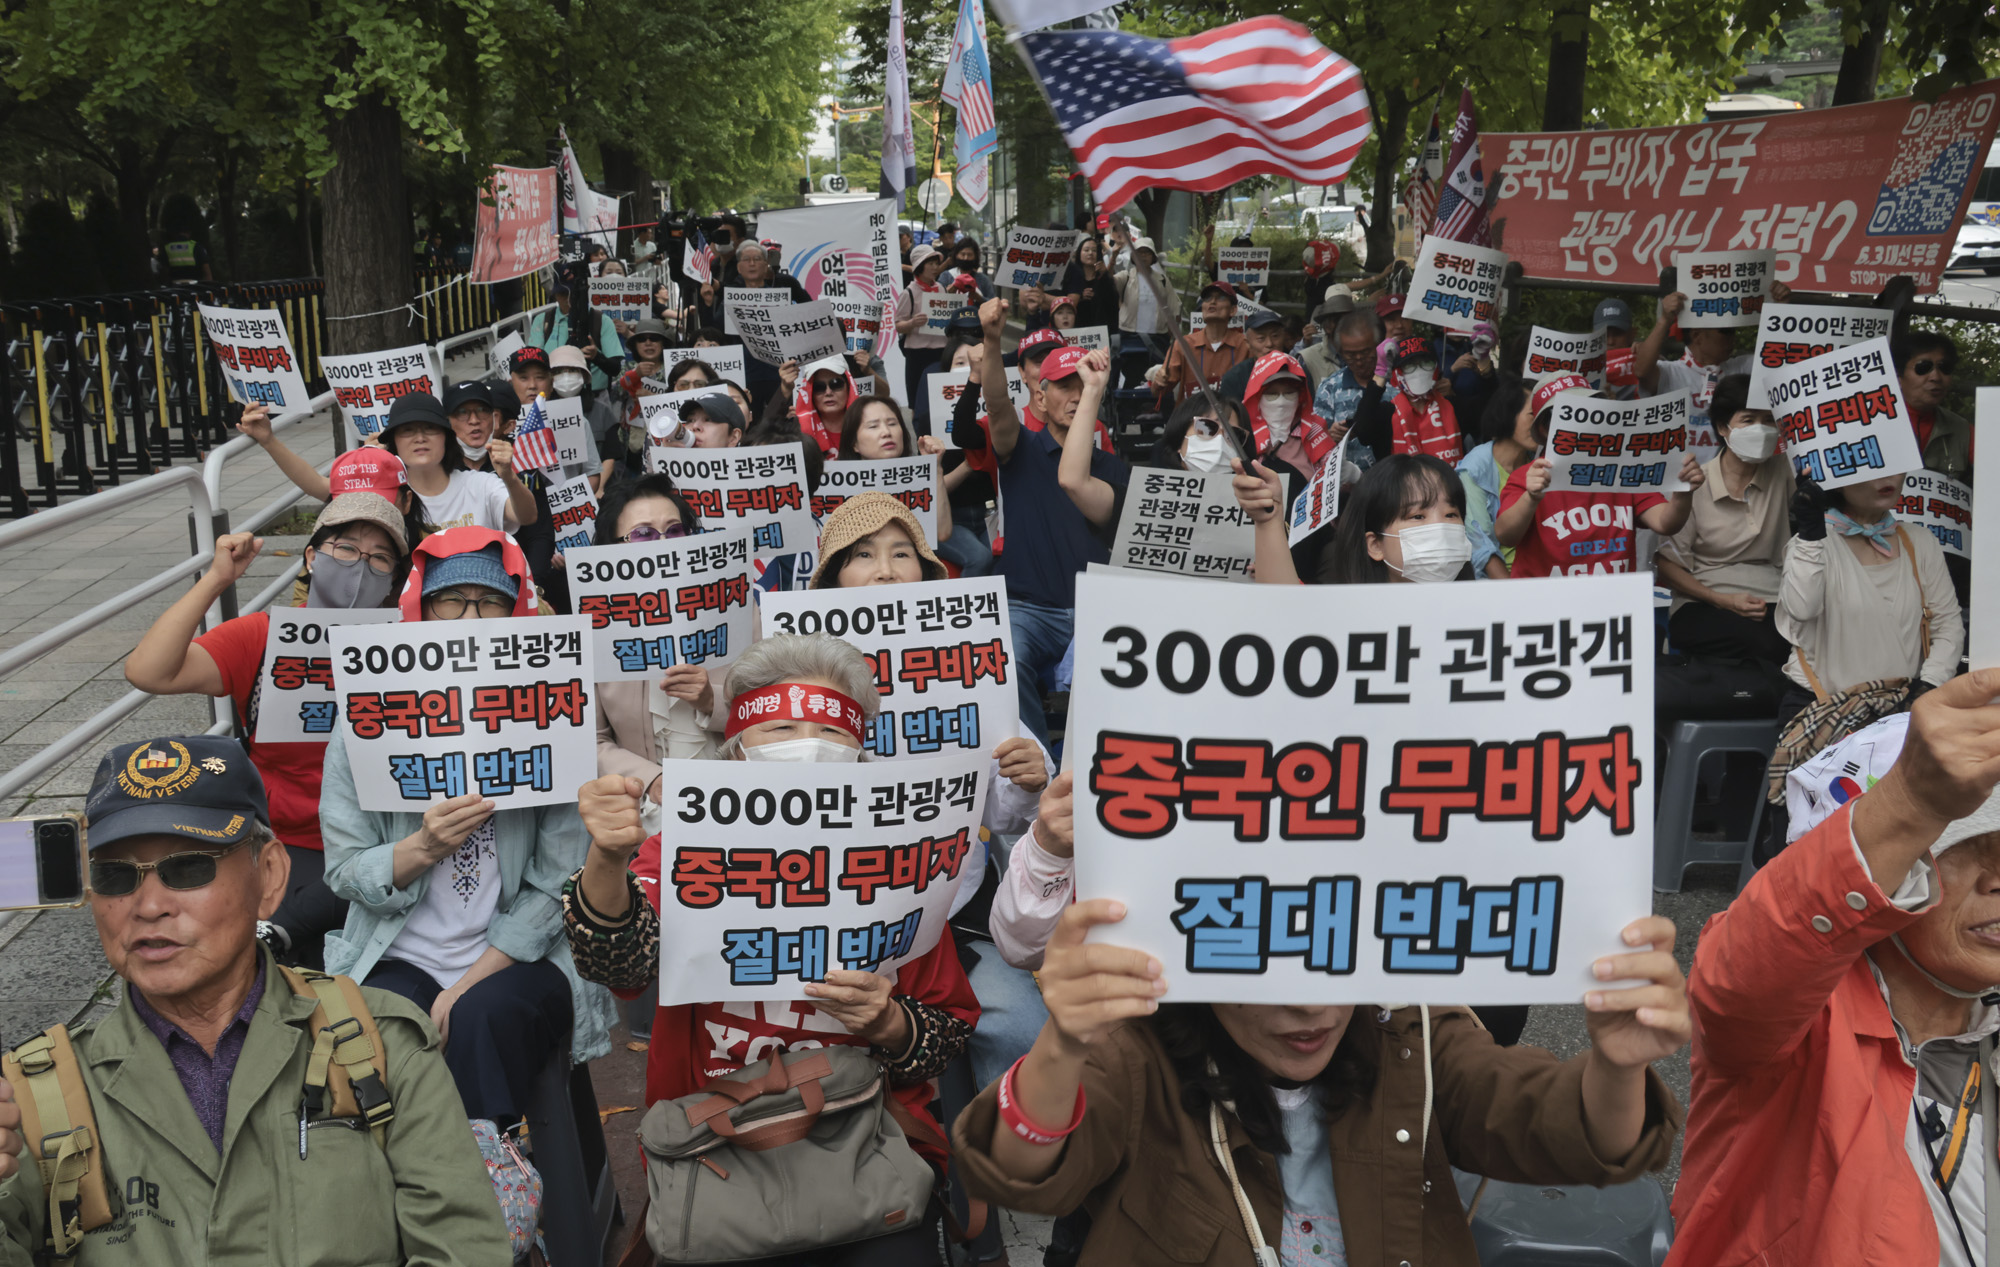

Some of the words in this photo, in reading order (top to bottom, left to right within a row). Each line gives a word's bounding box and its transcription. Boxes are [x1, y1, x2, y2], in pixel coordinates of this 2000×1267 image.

[1498, 136, 1580, 200] 중국인
[1578, 129, 1680, 200] 무비자
[1679, 121, 1768, 197] 입국
[1013, 232, 1055, 248] 3000만
[1560, 210, 1637, 277] 관광
[1007, 247, 1045, 268] 중국인
[1220, 250, 1249, 259] 3000만
[1433, 252, 1476, 277] 중국인
[1690, 263, 1732, 280] 중국인
[1735, 261, 1768, 277] 관광객
[1850, 271, 1878, 286] STOP
[591, 282, 625, 291] 3000만
[626, 282, 650, 291] 관광객
[727, 293, 762, 301] 3000만
[765, 292, 789, 301] 관광객
[1698, 278, 1761, 294] 3000만명
[733, 307, 771, 323] 중국인
[1421, 289, 1473, 319] 무비자
[1690, 297, 1740, 317] 무비자
[237, 319, 282, 338] 관광객
[739, 321, 777, 337] 관광객
[779, 314, 835, 338] 유치보다
[1080, 334, 1101, 343] 관광객
[1767, 315, 1847, 338] 3000만
[1850, 317, 1889, 339] 관광객
[670, 350, 700, 362] 중국인
[1059, 352, 1071, 363] STOP
[1072, 351, 1081, 359] THE
[1534, 335, 1588, 355] 3000만
[237, 345, 293, 373] 무비자
[324, 362, 374, 380] 3000만
[377, 353, 427, 377] 관광객
[333, 385, 374, 409] 중국인
[373, 374, 434, 407] 무비자
[1540, 377, 1575, 400] 이재명
[1767, 371, 1819, 409] 3000만
[1823, 350, 1887, 391] 관광객
[247, 380, 287, 407] 반대
[353, 414, 381, 437] 절대
[1559, 404, 1641, 428] 3000만
[1643, 398, 1687, 427] 관광객
[1777, 405, 1817, 446] 국인
[1817, 384, 1899, 435] 무비자
[1553, 429, 1625, 458] 중국인
[1626, 425, 1688, 457] 무비자
[338, 464, 358, 477] STOP
[358, 463, 379, 474] THE
[657, 460, 730, 481] 3000만
[735, 453, 798, 479] 관광객
[1824, 434, 1886, 479] 반대
[344, 478, 375, 491] STEAL
[820, 469, 877, 488] 000만
[881, 463, 932, 487] 관광객
[1144, 473, 1206, 499] 중국인
[1569, 463, 1618, 486] 절대
[1619, 461, 1667, 487] 반대
[547, 483, 589, 508] 관광객
[671, 488, 725, 518] 국인
[727, 481, 805, 518] 무비자
[1138, 498, 1201, 523] 관광객
[1541, 503, 1633, 540] YOON
[753, 522, 784, 552] 대
[1132, 521, 1194, 546] 자국민
[1570, 536, 1627, 557] GREAT
[576, 551, 681, 583] 3000만
[686, 538, 748, 574] 관광객
[1127, 545, 1188, 571] 안전이
[579, 588, 673, 630] 중국인
[675, 572, 750, 621] 무비자
[915, 591, 1001, 633] 관광객
[342, 636, 481, 676] 3000만
[489, 630, 583, 672] 관광객
[613, 635, 678, 672] 절대
[679, 622, 729, 665] 반대
[1099, 624, 1421, 706] 3000만
[1440, 614, 1634, 704] 관광객
[898, 638, 1009, 694] 무비자
[346, 686, 466, 740] 중국인
[470, 678, 588, 734] 무비자
[738, 693, 781, 721] 이재명
[807, 694, 842, 718] 투쟁
[902, 702, 981, 755] 반대
[117, 769, 152, 799] VIETNAM
[154, 764, 202, 798] VETERAN
[389, 751, 468, 801] 절대
[473, 744, 554, 798] 반대
[1089, 730, 1368, 843] 중국인
[1380, 725, 1642, 843] 무비자
[677, 785, 858, 829] 3000만
[867, 770, 979, 828] 관광객
[172, 823, 226, 838] VIETNAM
[222, 814, 246, 837] VETERAN
[672, 845, 831, 909] 중국인
[838, 826, 971, 906] 무비자
[1169, 874, 1362, 975] 절대
[1373, 874, 1565, 976] 반대
[720, 925, 830, 986] 절대
[837, 907, 924, 975] 반대
[146, 1208, 176, 1228] FUTURE
